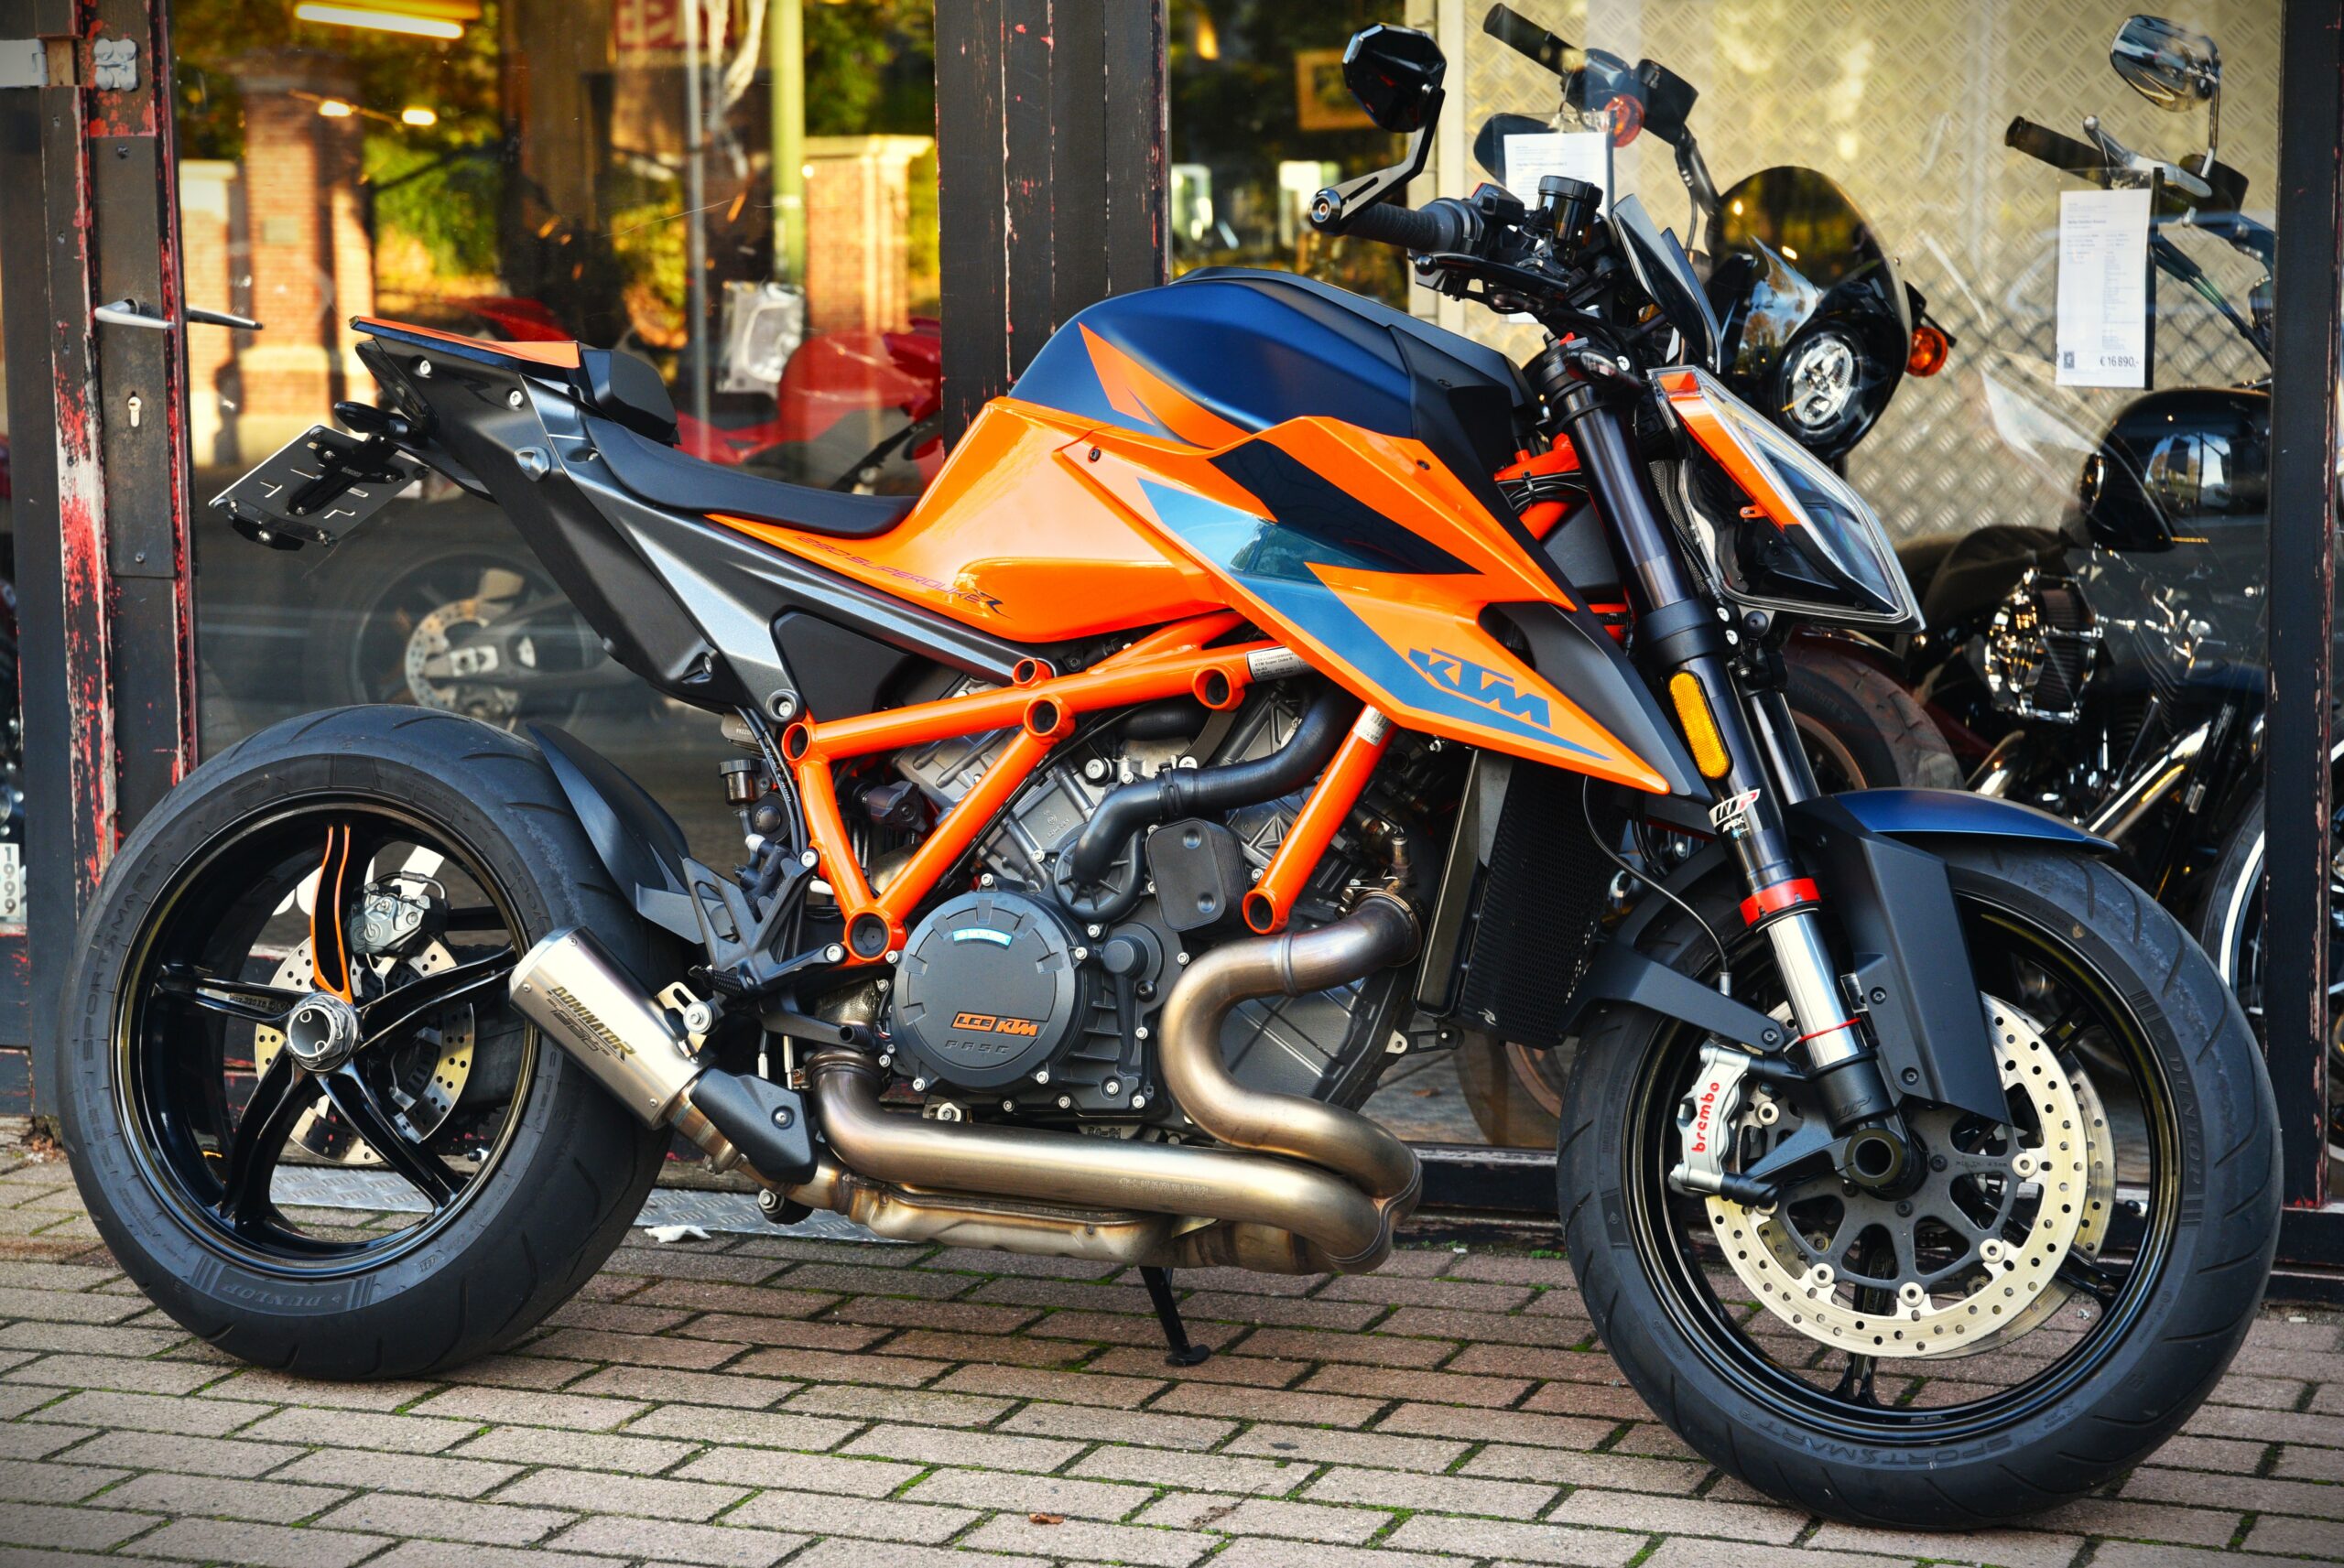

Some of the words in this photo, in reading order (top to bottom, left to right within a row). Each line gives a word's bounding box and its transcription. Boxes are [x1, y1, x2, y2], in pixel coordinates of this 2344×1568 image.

[1408, 647, 1551, 729] KTM
[1722, 816, 1744, 833] APEX
[3, 846, 16, 914] 1999
[551, 986, 636, 1062] DOMINATOR
[995, 1019, 1038, 1036] KTM
[1691, 1082, 1721, 1153] brembo
[2167, 1050, 2203, 1188] DUNLOP
[221, 1279, 327, 1309] DUNLOP
